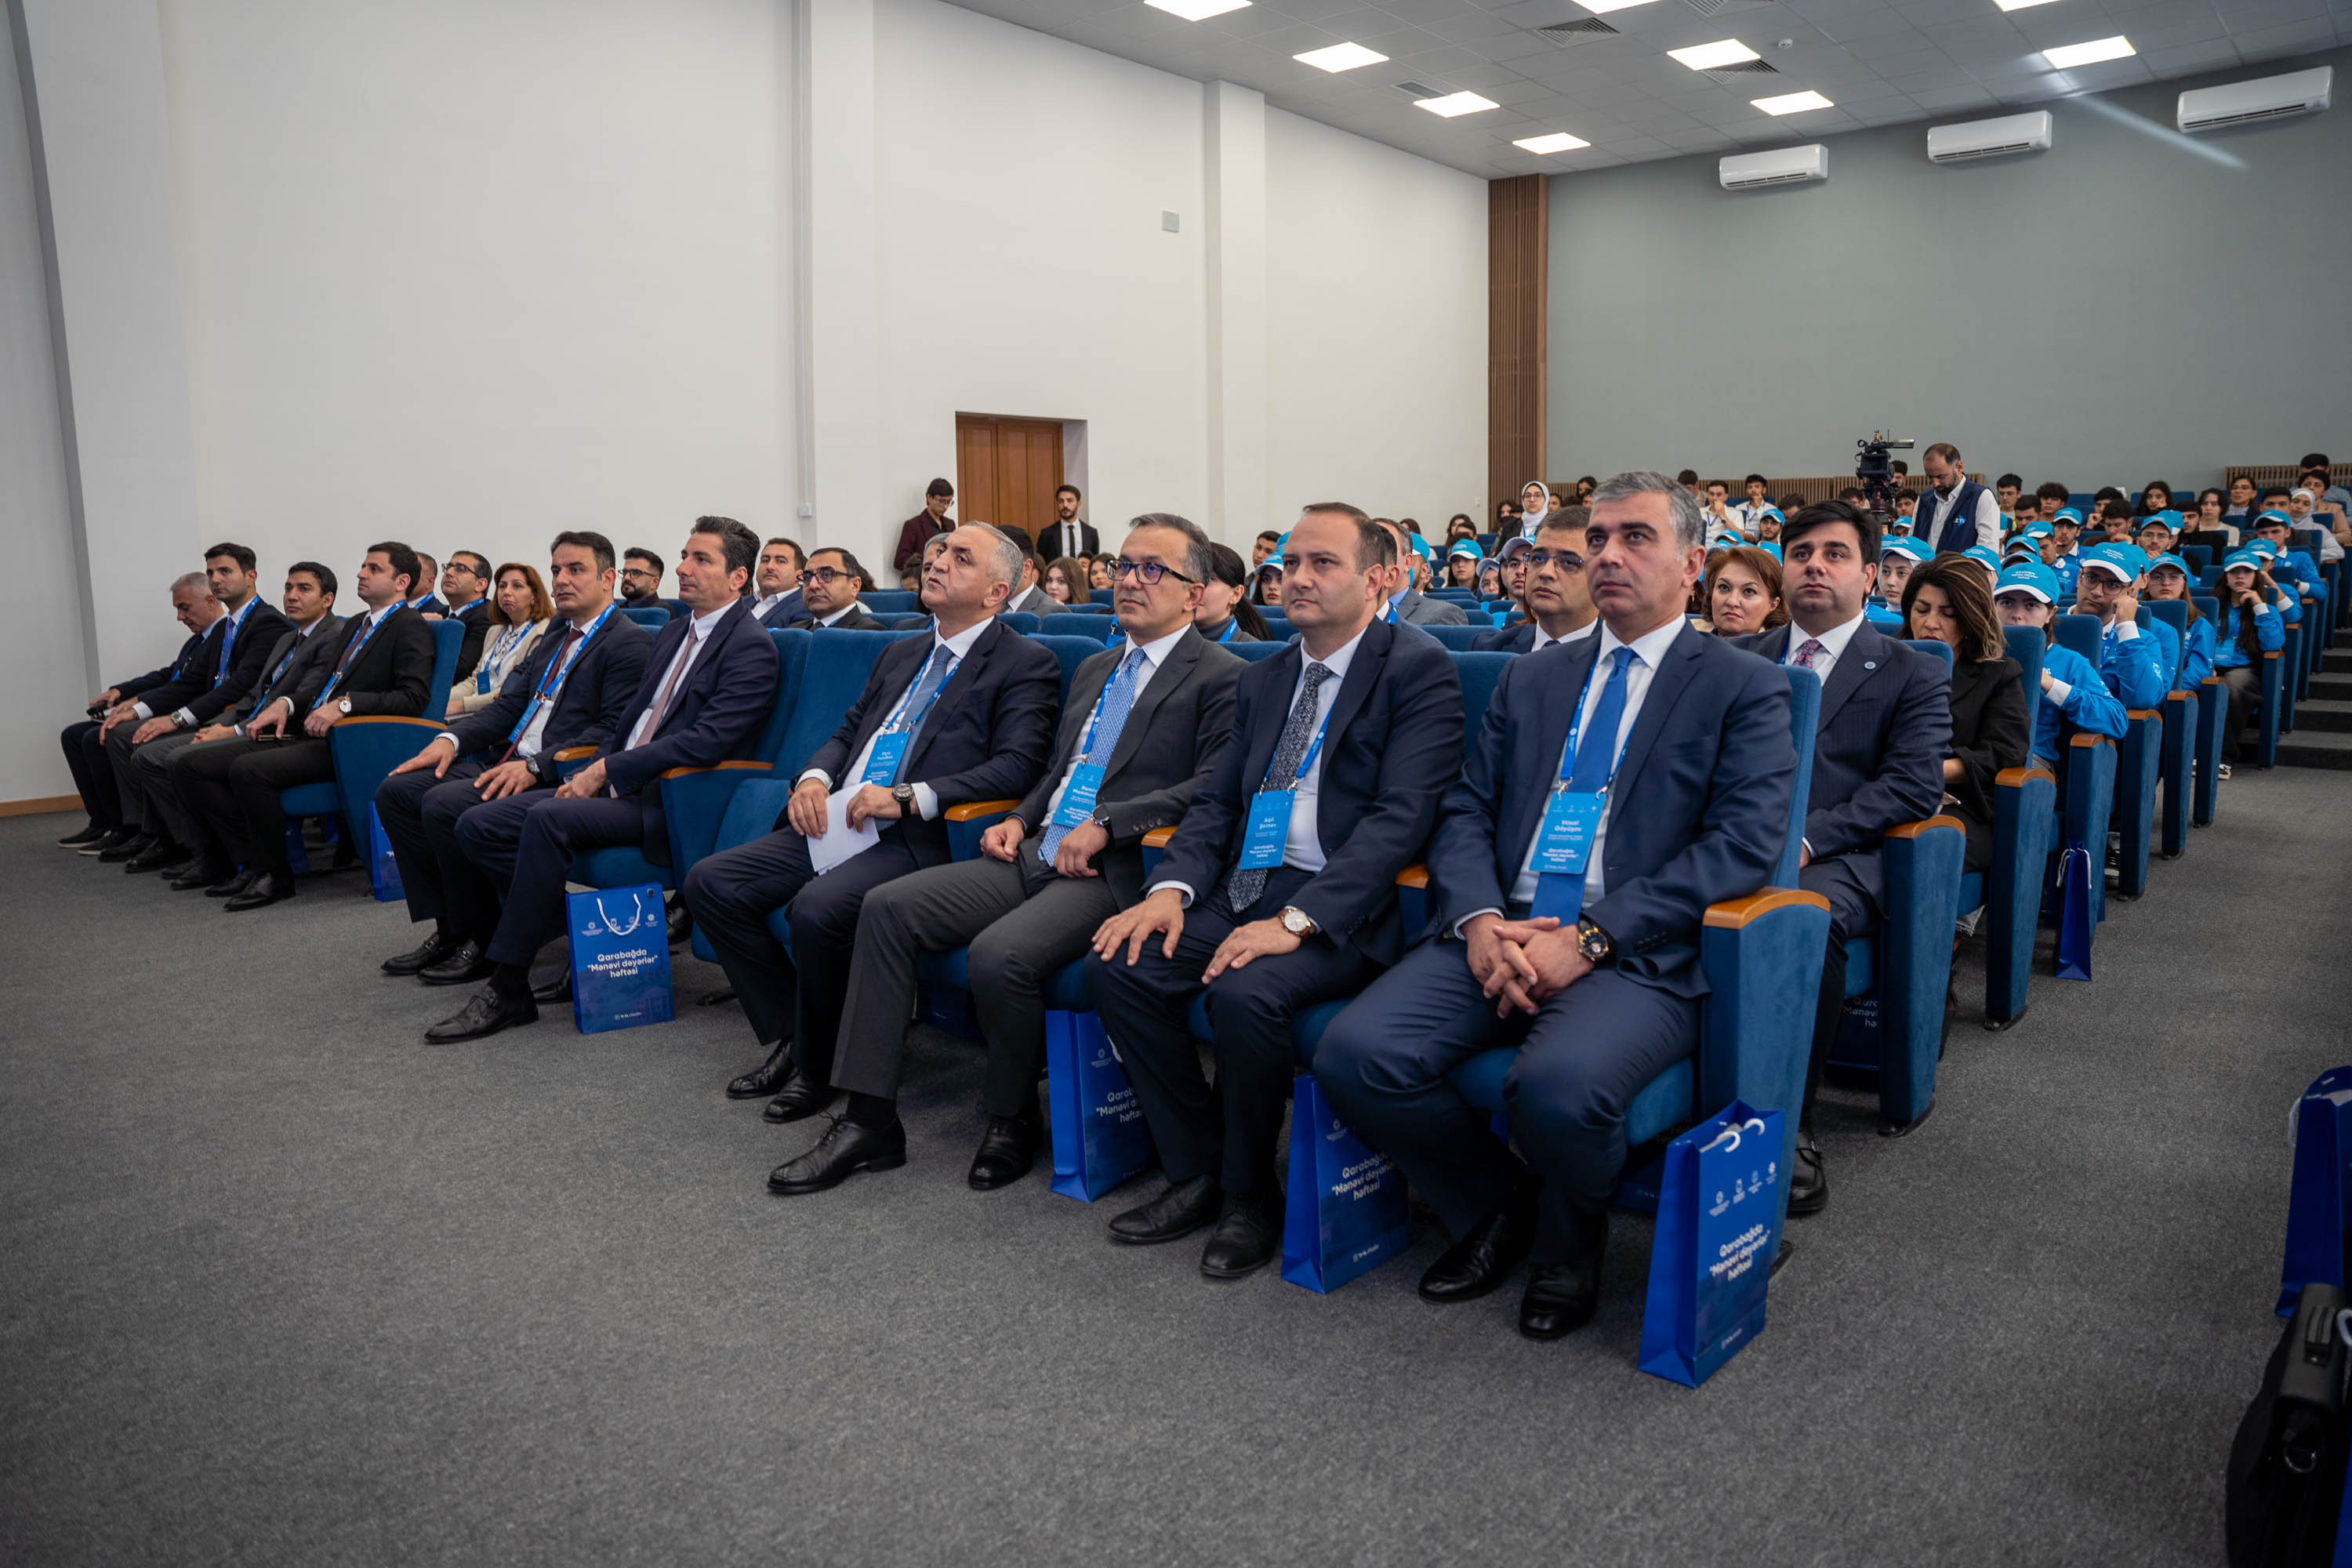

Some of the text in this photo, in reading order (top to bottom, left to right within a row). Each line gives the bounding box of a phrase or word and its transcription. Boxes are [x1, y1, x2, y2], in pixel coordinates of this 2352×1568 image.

[597, 948, 647, 962] Qarabağda
[587, 960, 620, 972] "Mənəvi
[610, 967, 638, 978] həftəsi
[1107, 1087, 1134, 1102] Qarab
[1120, 1110, 1142, 1123] həftə
